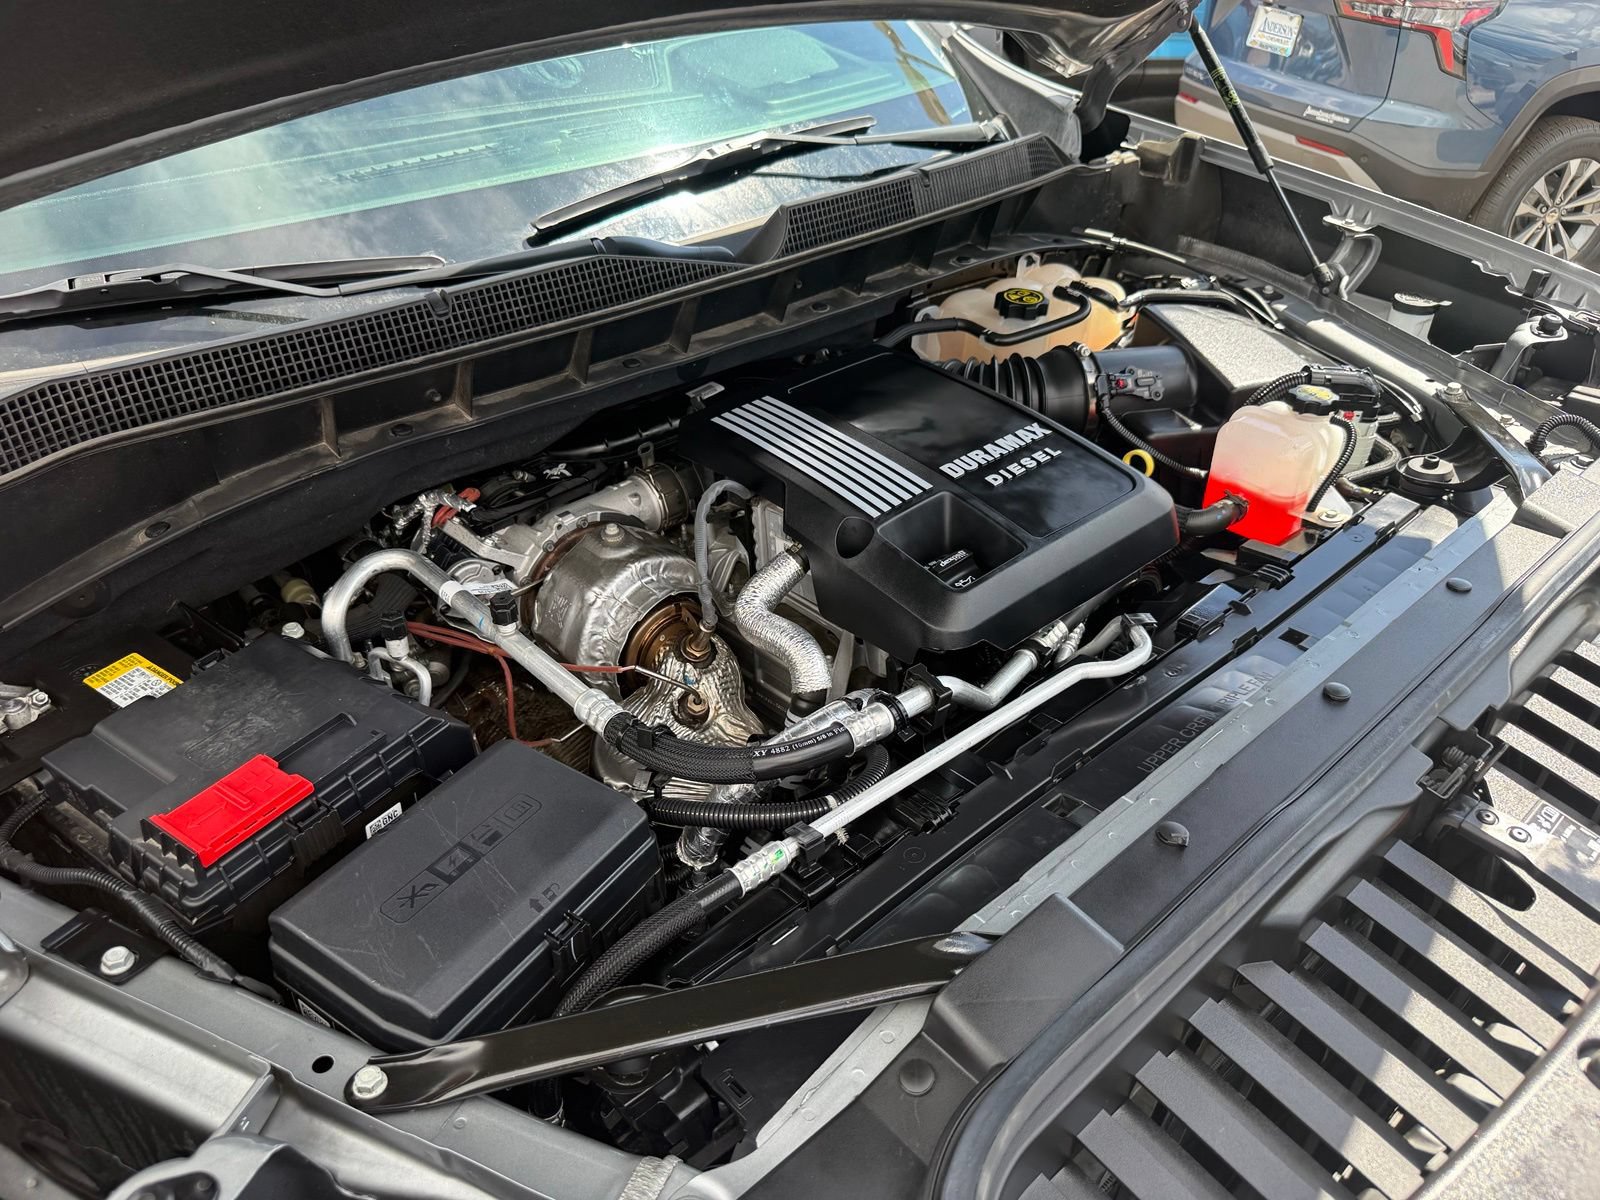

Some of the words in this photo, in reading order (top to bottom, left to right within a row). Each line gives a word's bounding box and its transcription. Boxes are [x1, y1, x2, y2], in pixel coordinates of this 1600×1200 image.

[939, 422, 1053, 479] DURAMAX
[984, 447, 1062, 487] DIESEL
[1137, 737, 1183, 772] UPPER
[1248, 671, 1272, 687] FAN
[753, 749, 768, 758] XY
[771, 745, 790, 754] 4882
